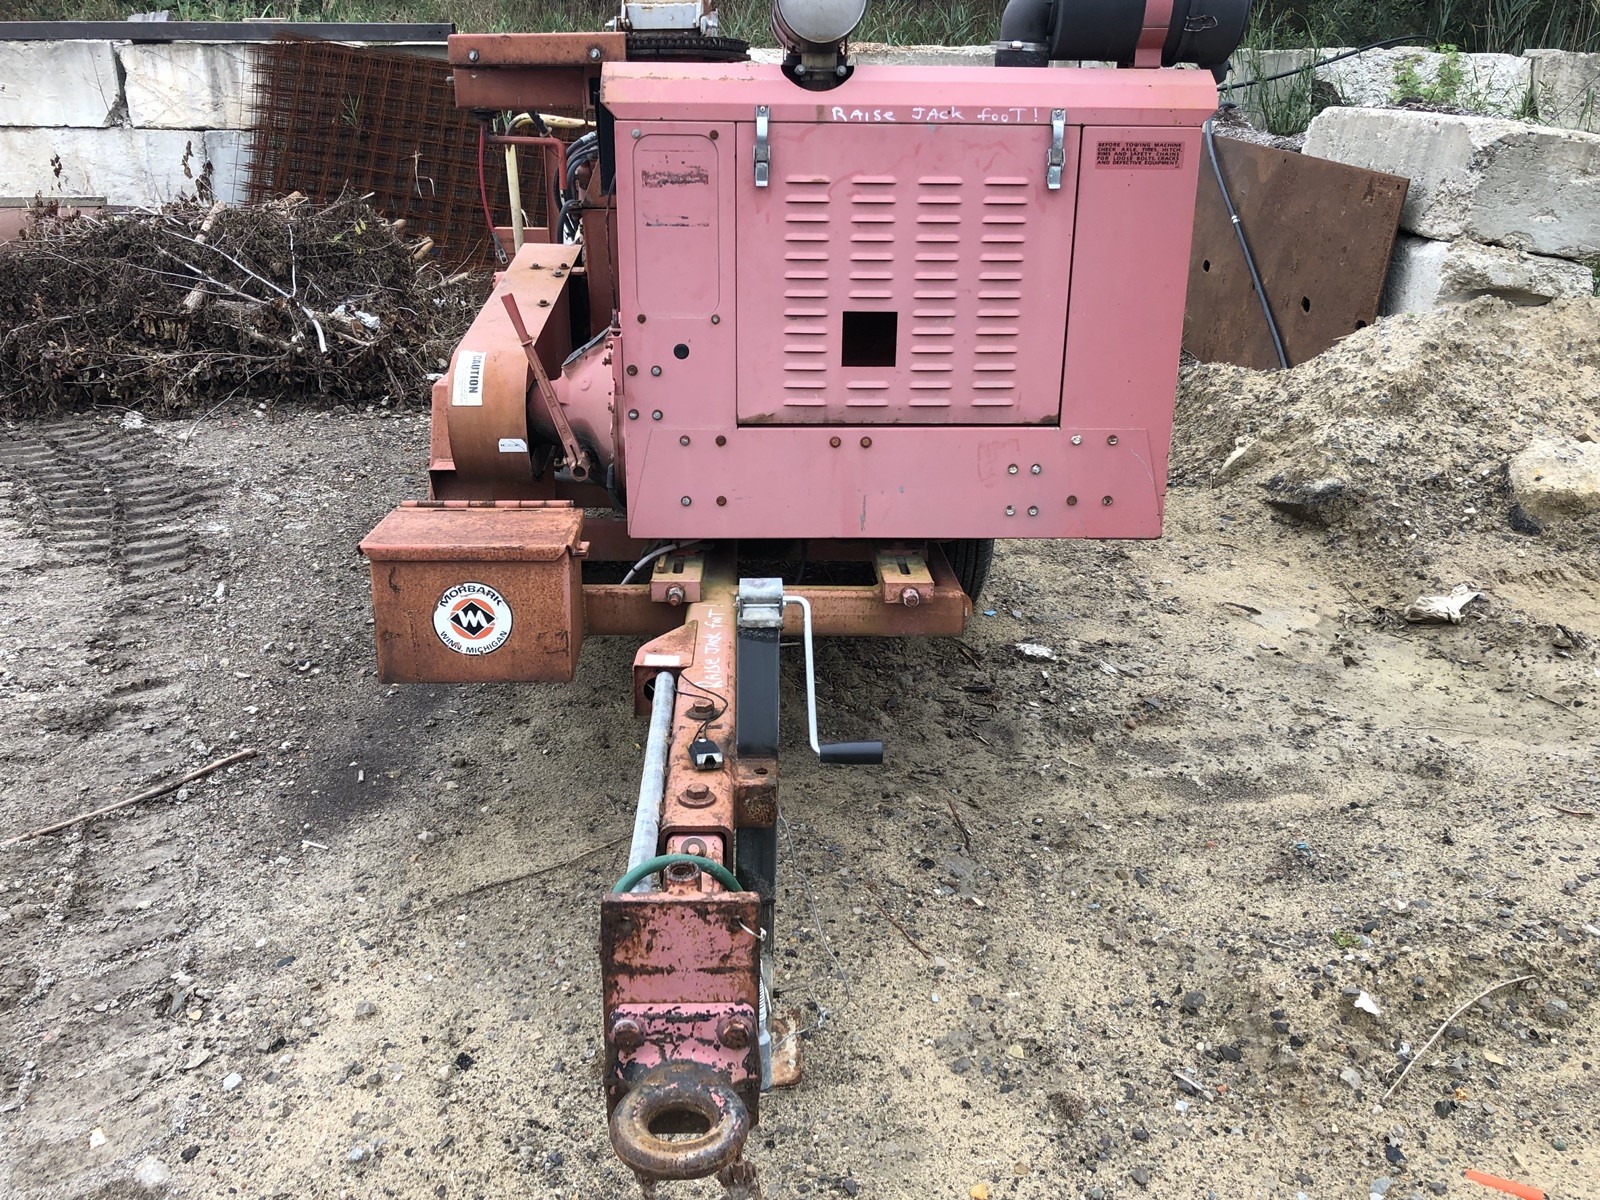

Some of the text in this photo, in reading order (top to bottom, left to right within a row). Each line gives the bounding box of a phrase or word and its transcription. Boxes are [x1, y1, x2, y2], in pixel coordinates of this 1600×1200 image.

[469, 355, 483, 394] CAUTION
[439, 585, 505, 608] MORBARK
[465, 630, 508, 654] MICHIGAN
